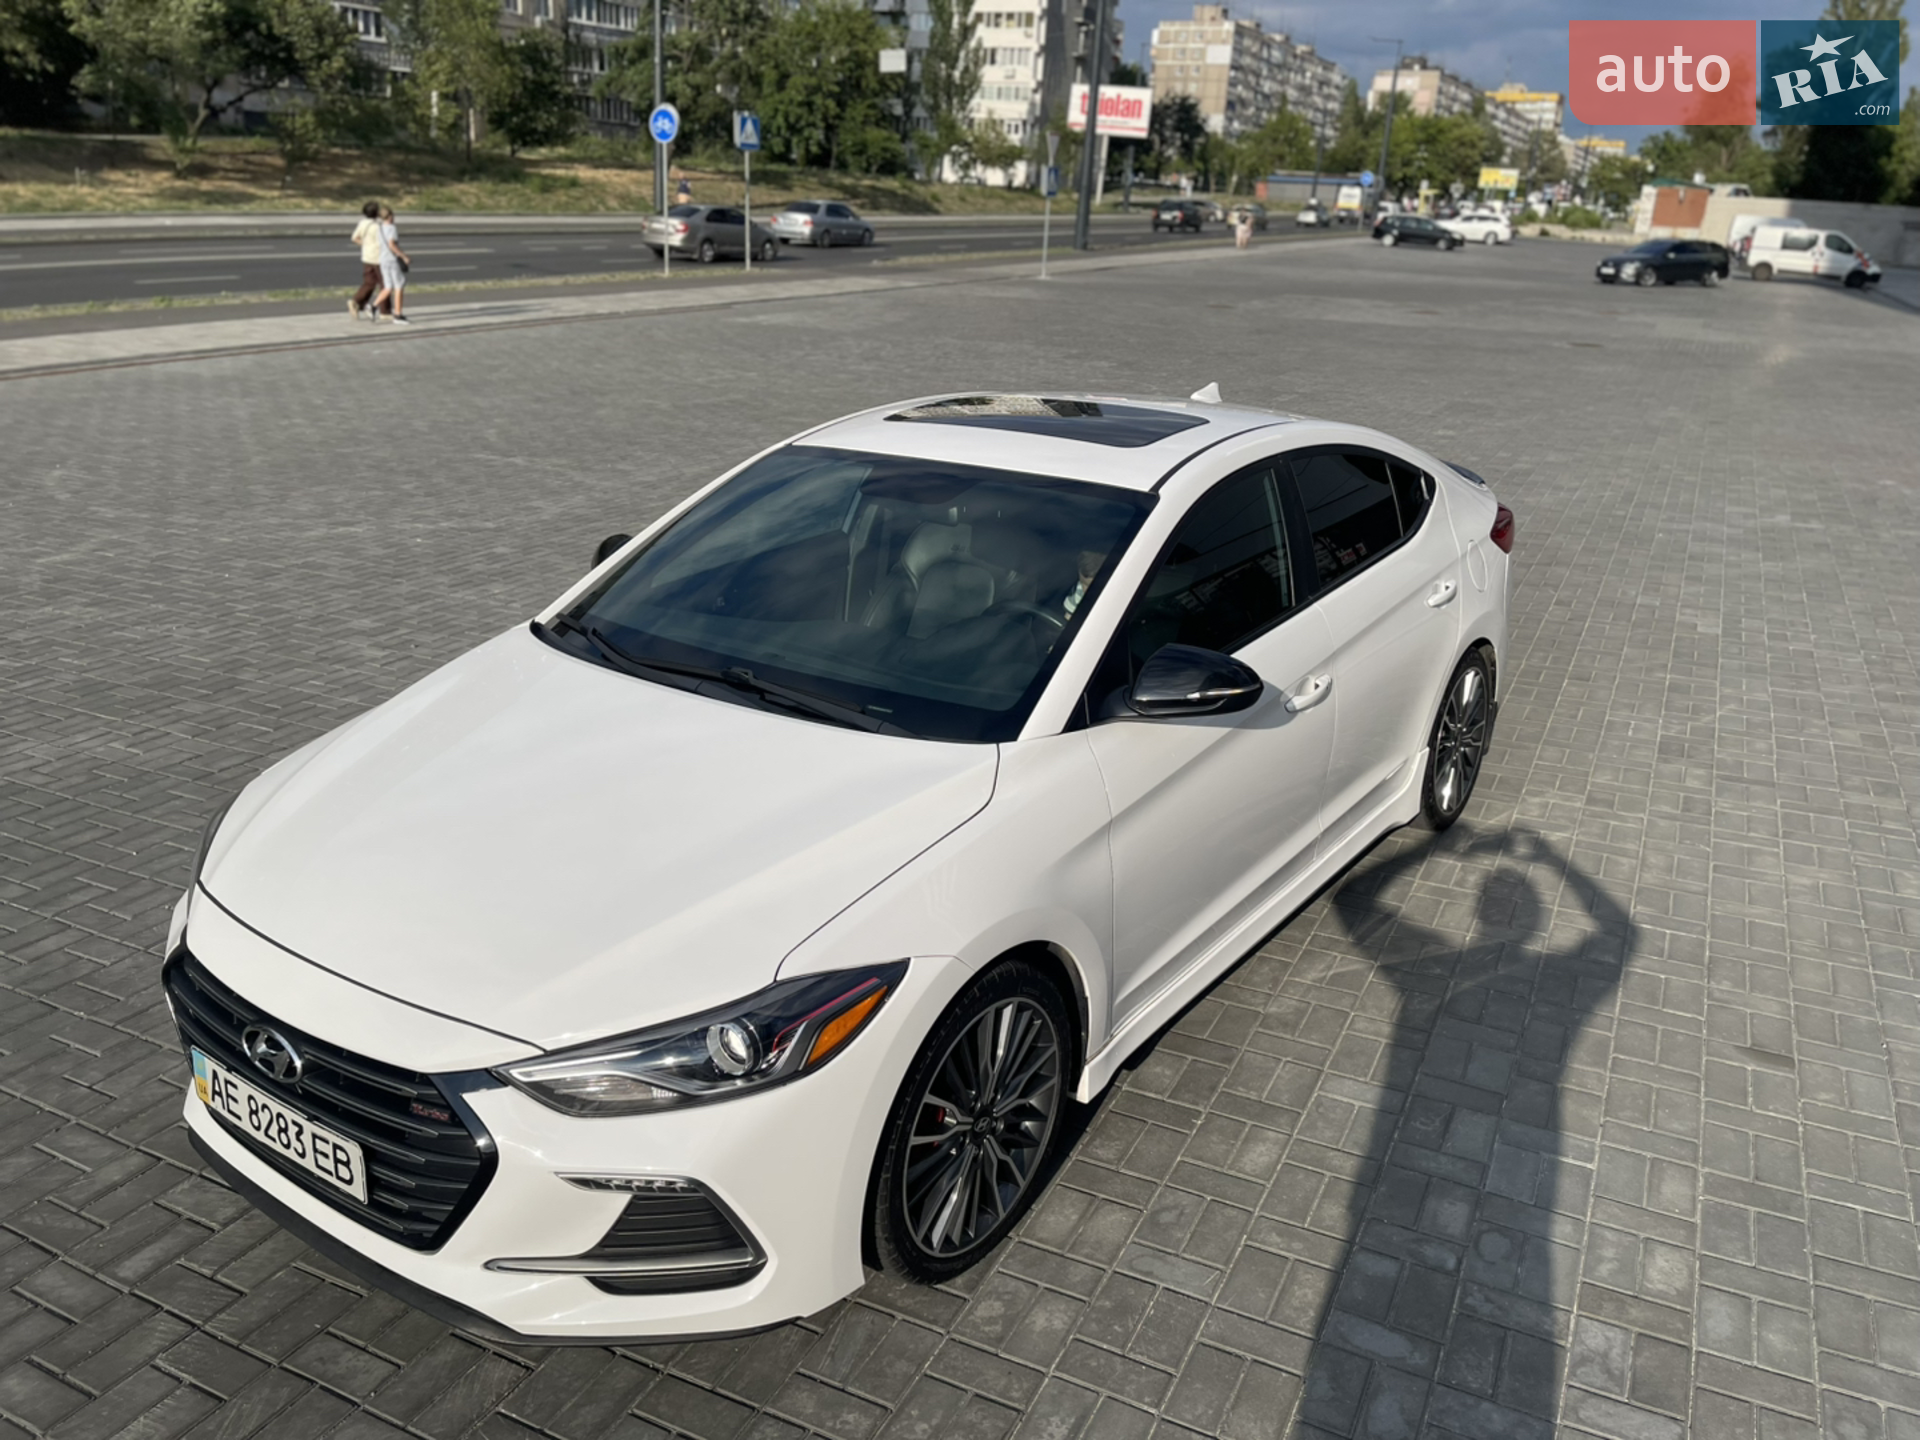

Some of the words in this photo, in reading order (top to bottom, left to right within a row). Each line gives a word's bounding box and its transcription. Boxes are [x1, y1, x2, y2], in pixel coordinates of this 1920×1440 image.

[1081, 92, 1143, 119] tiolan
[211, 1069, 242, 1122] AE
[247, 1094, 306, 1160] 8283
[311, 1131, 354, 1187] EB
